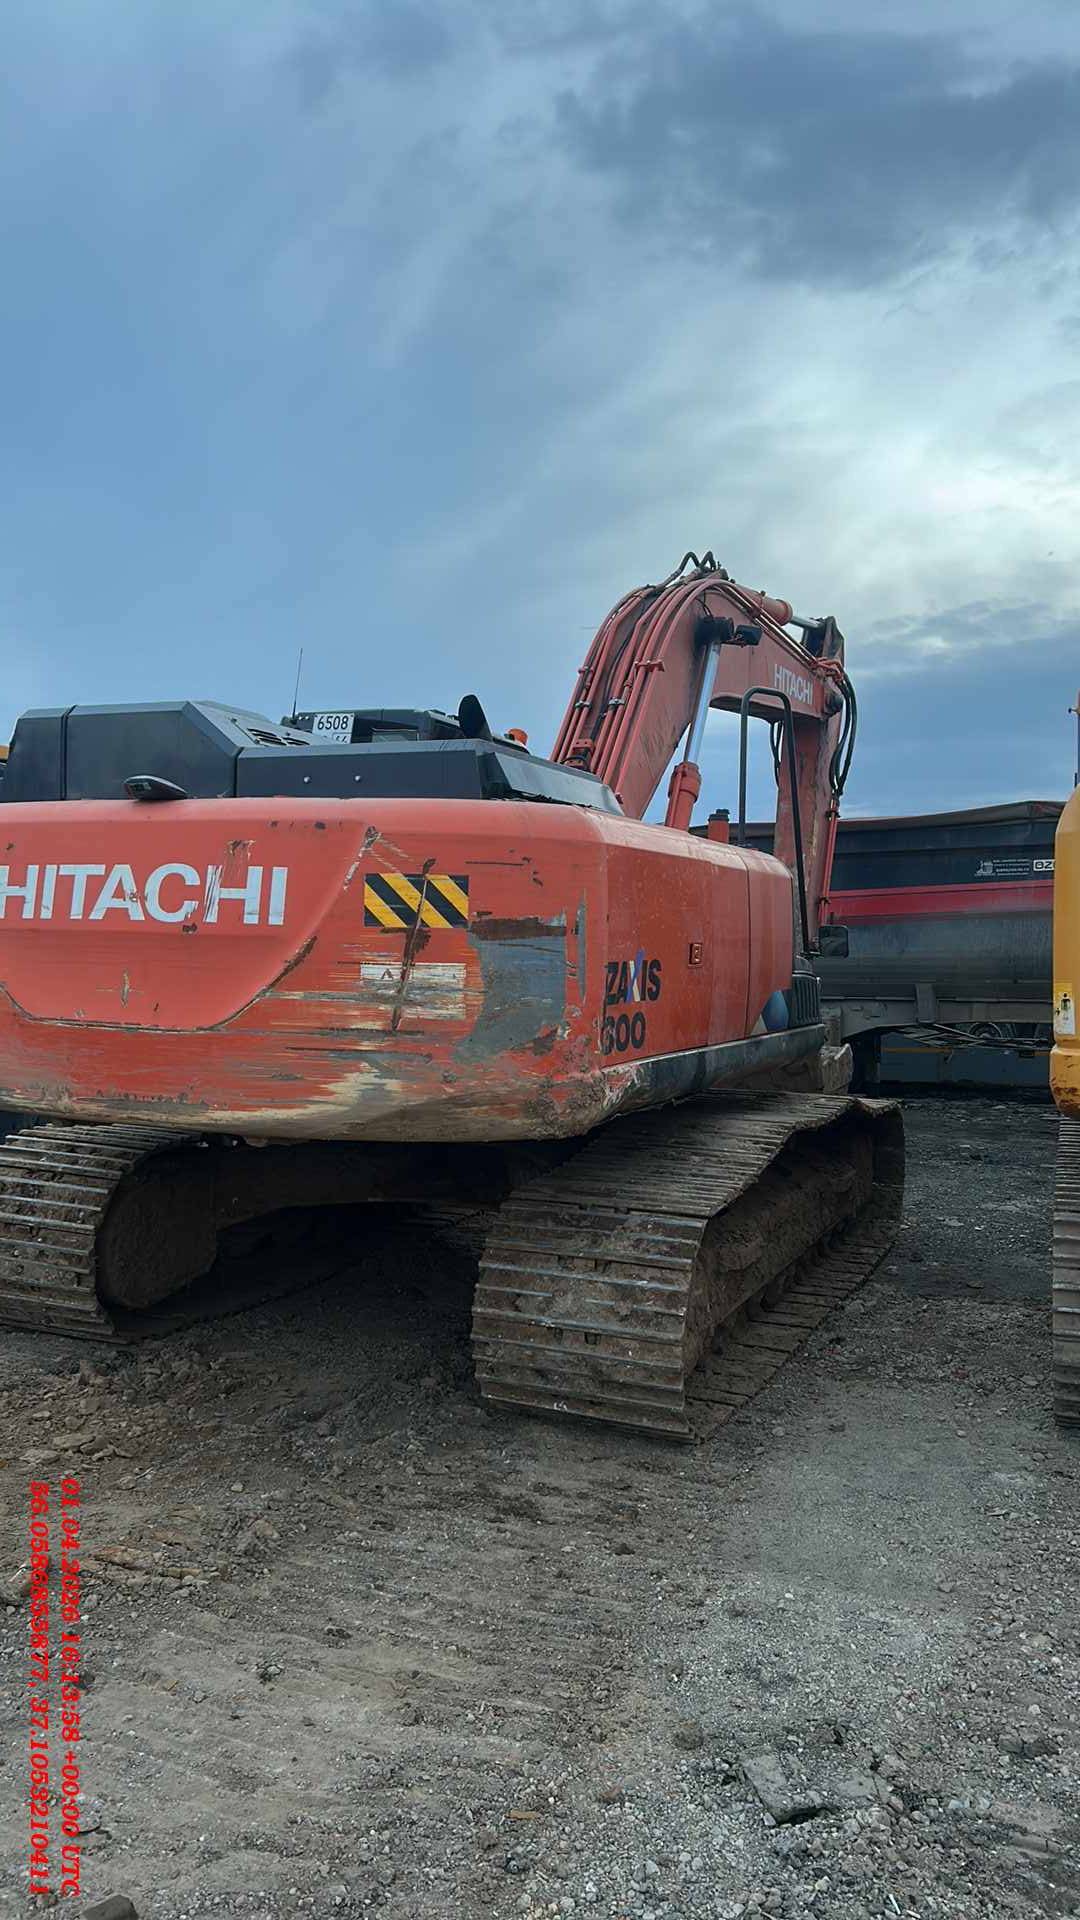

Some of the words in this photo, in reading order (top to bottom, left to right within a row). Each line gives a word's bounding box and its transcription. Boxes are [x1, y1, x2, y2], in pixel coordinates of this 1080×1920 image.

[774, 663, 814, 705] HITACHI
[317, 715, 349, 730] 6508
[1034, 861, 1056, 870] OZ
[0, 863, 289, 926] HITACHI
[605, 947, 662, 1006] ZAXIS
